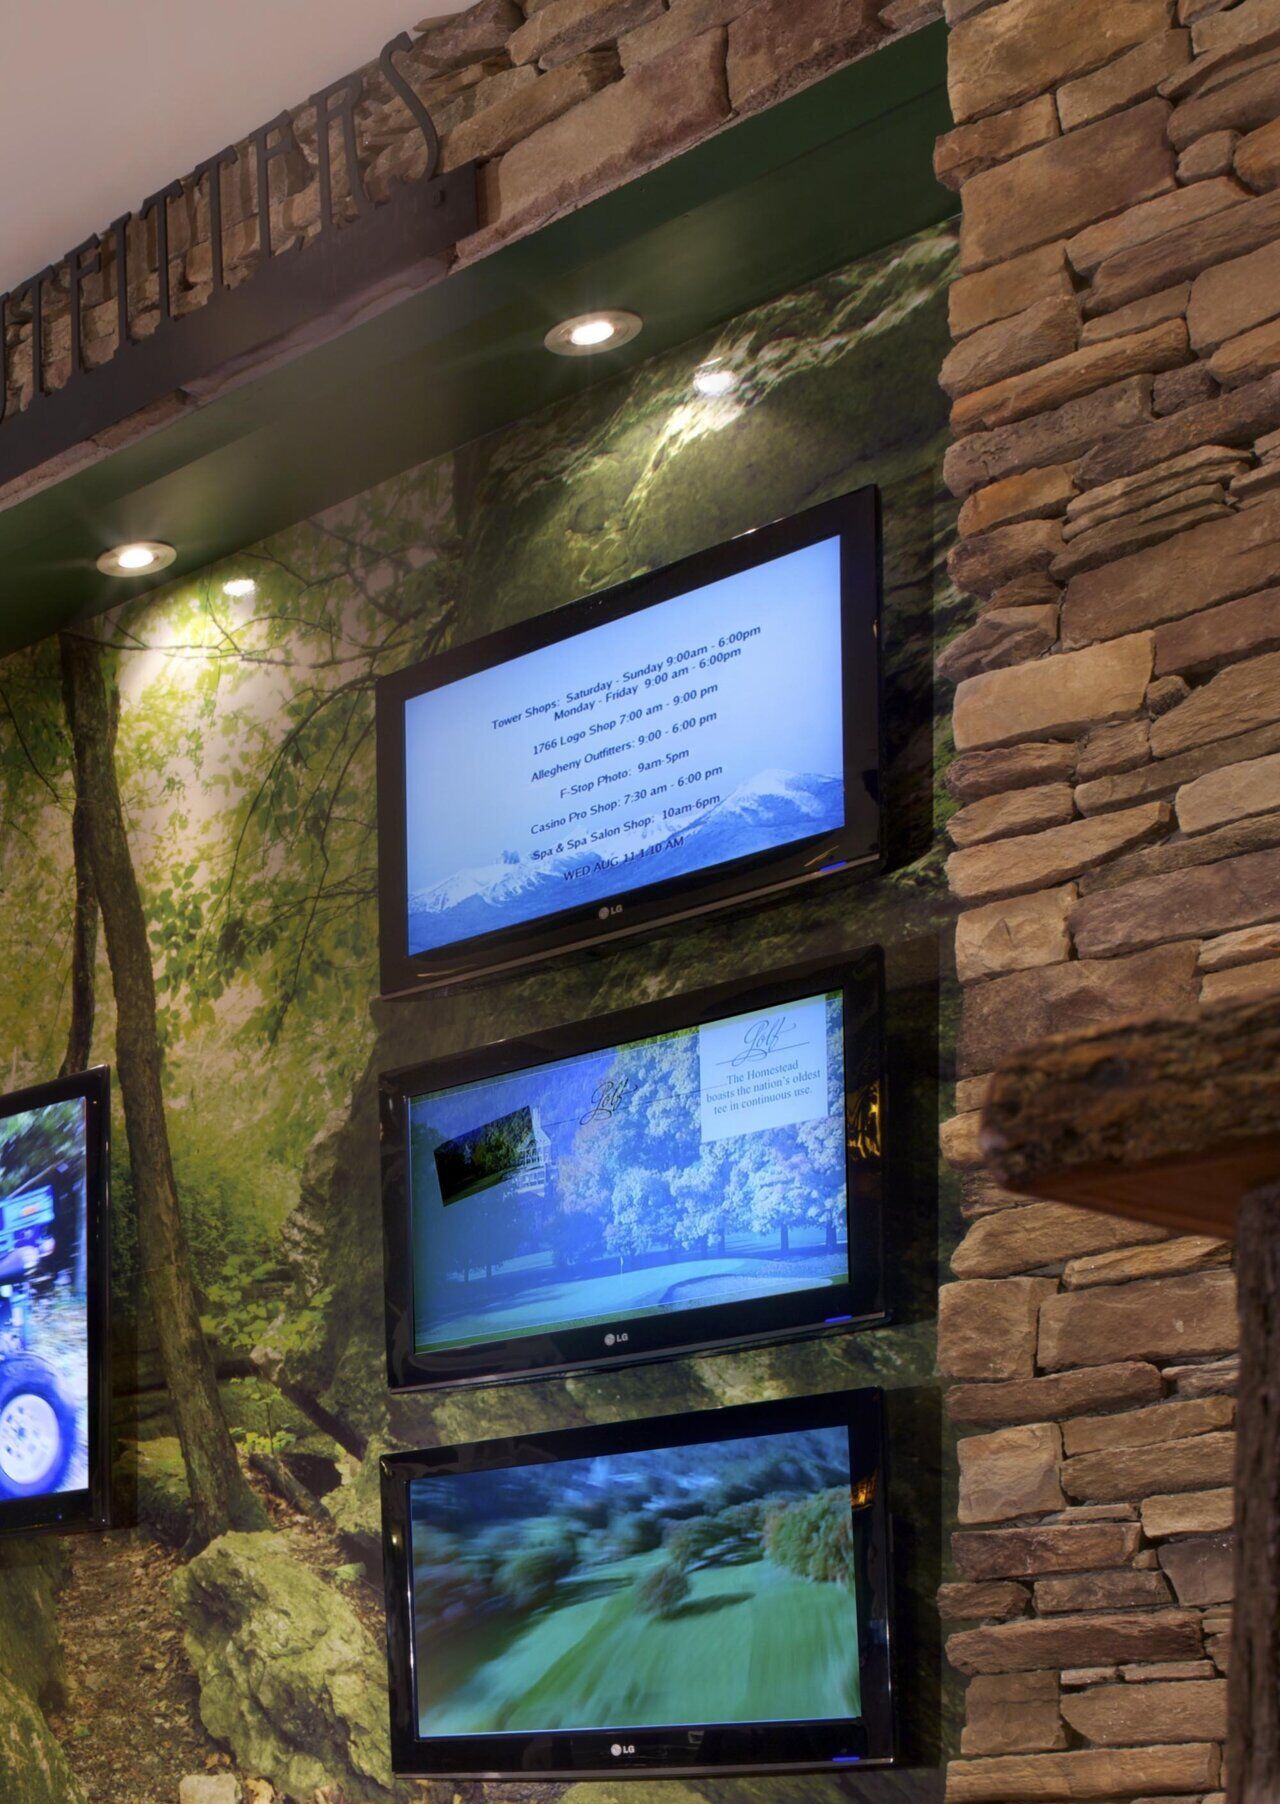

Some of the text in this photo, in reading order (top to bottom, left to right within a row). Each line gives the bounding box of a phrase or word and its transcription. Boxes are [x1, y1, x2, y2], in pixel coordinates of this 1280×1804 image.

[492, 625, 761, 730] Tower Shops: Saturday Sunday 9:00am 6:00pm
[554, 647, 742, 721] Monday Friday 9:00 am 6:00pm
[533, 683, 718, 755] 1766 Logo Shop 7:00 am 9:00 pm
[531, 711, 717, 782] Allegheny Outfitters: 9:00 6:00 pm
[560, 749, 690, 799] F-Stop Photo: 9am-5pm
[531, 766, 723, 835] Casino Pro Shop: 7:30 am 6:00 pm
[533, 848, 553, 861] Spa
[556, 843, 564, 853] &
[567, 837, 587, 851] Spa
[591, 825, 620, 843] Salon
[624, 816, 655, 832] Shop:
[563, 865, 591, 881] WED
[593, 856, 619, 873] AUG
[665, 836, 685, 850] AM
[610, 904, 623, 915] LG
[706, 1070, 821, 1103] boasts the nation's oldest
[727, 1060, 799, 1085] The Homestead
[714, 1105, 727, 1115] tee
[730, 1101, 739, 1111] in
[742, 1090, 791, 1109] continuous
[616, 1333, 629, 1343] LG
[623, 1745, 635, 1754] LG
